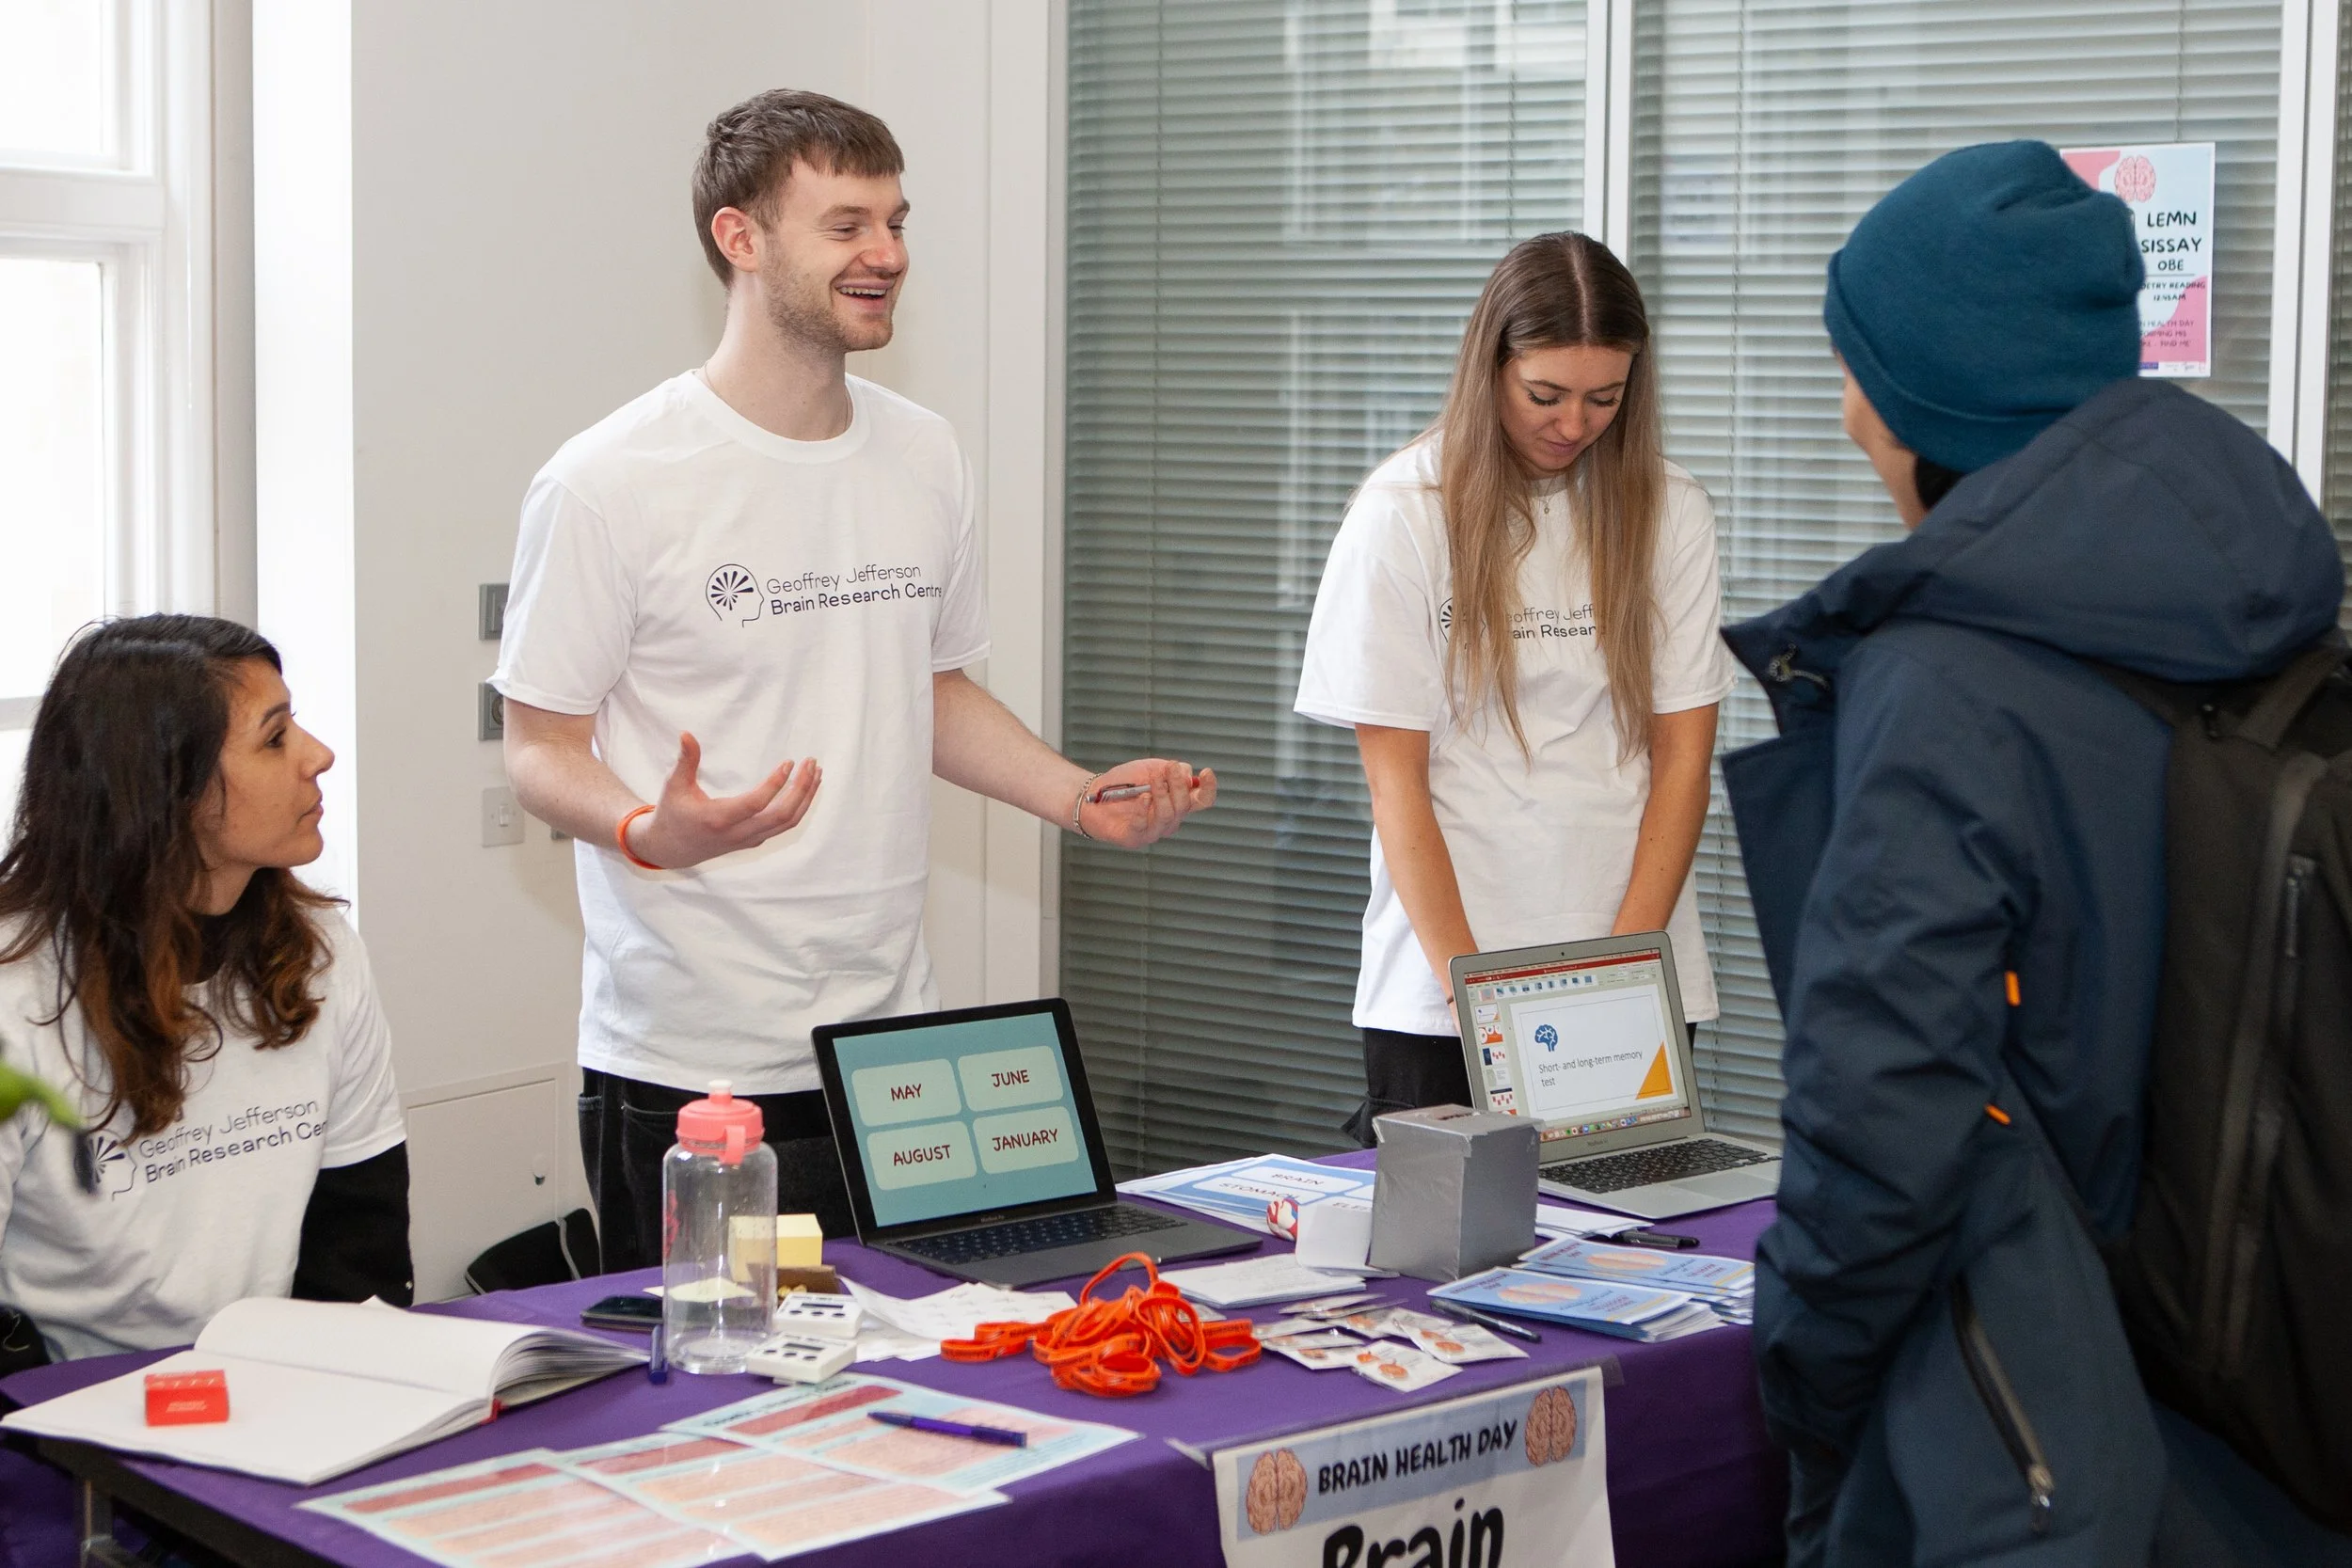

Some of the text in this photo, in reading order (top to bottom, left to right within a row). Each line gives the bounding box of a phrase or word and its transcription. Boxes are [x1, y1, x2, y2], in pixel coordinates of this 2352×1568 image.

[2147, 211, 2197, 228] LEMN
[2141, 238, 2202, 253] SISSAY
[2157, 259, 2185, 272] OBE
[2169, 281, 2205, 290] READING
[766, 564, 921, 594] Geoffrey Jefferson
[771, 594, 815, 615] Brain
[818, 583, 900, 609] Research
[1513, 625, 1597, 639] ain Resear
[1538, 1051, 1644, 1074] Short- and long-term memory
[890, 1069, 1030, 1101] MAY JUNE
[1541, 1077, 1556, 1088] test
[139, 1101, 318, 1159] Geoffrey Jefferson
[145, 1156, 186, 1183] Brain
[189, 1126, 292, 1167] Research
[893, 1129, 1058, 1167] AUGUST JANUARY
[1272, 1174, 1325, 1185] BRAIN
[1318, 1419, 1518, 1496] BRAIN HEALTH DAY
